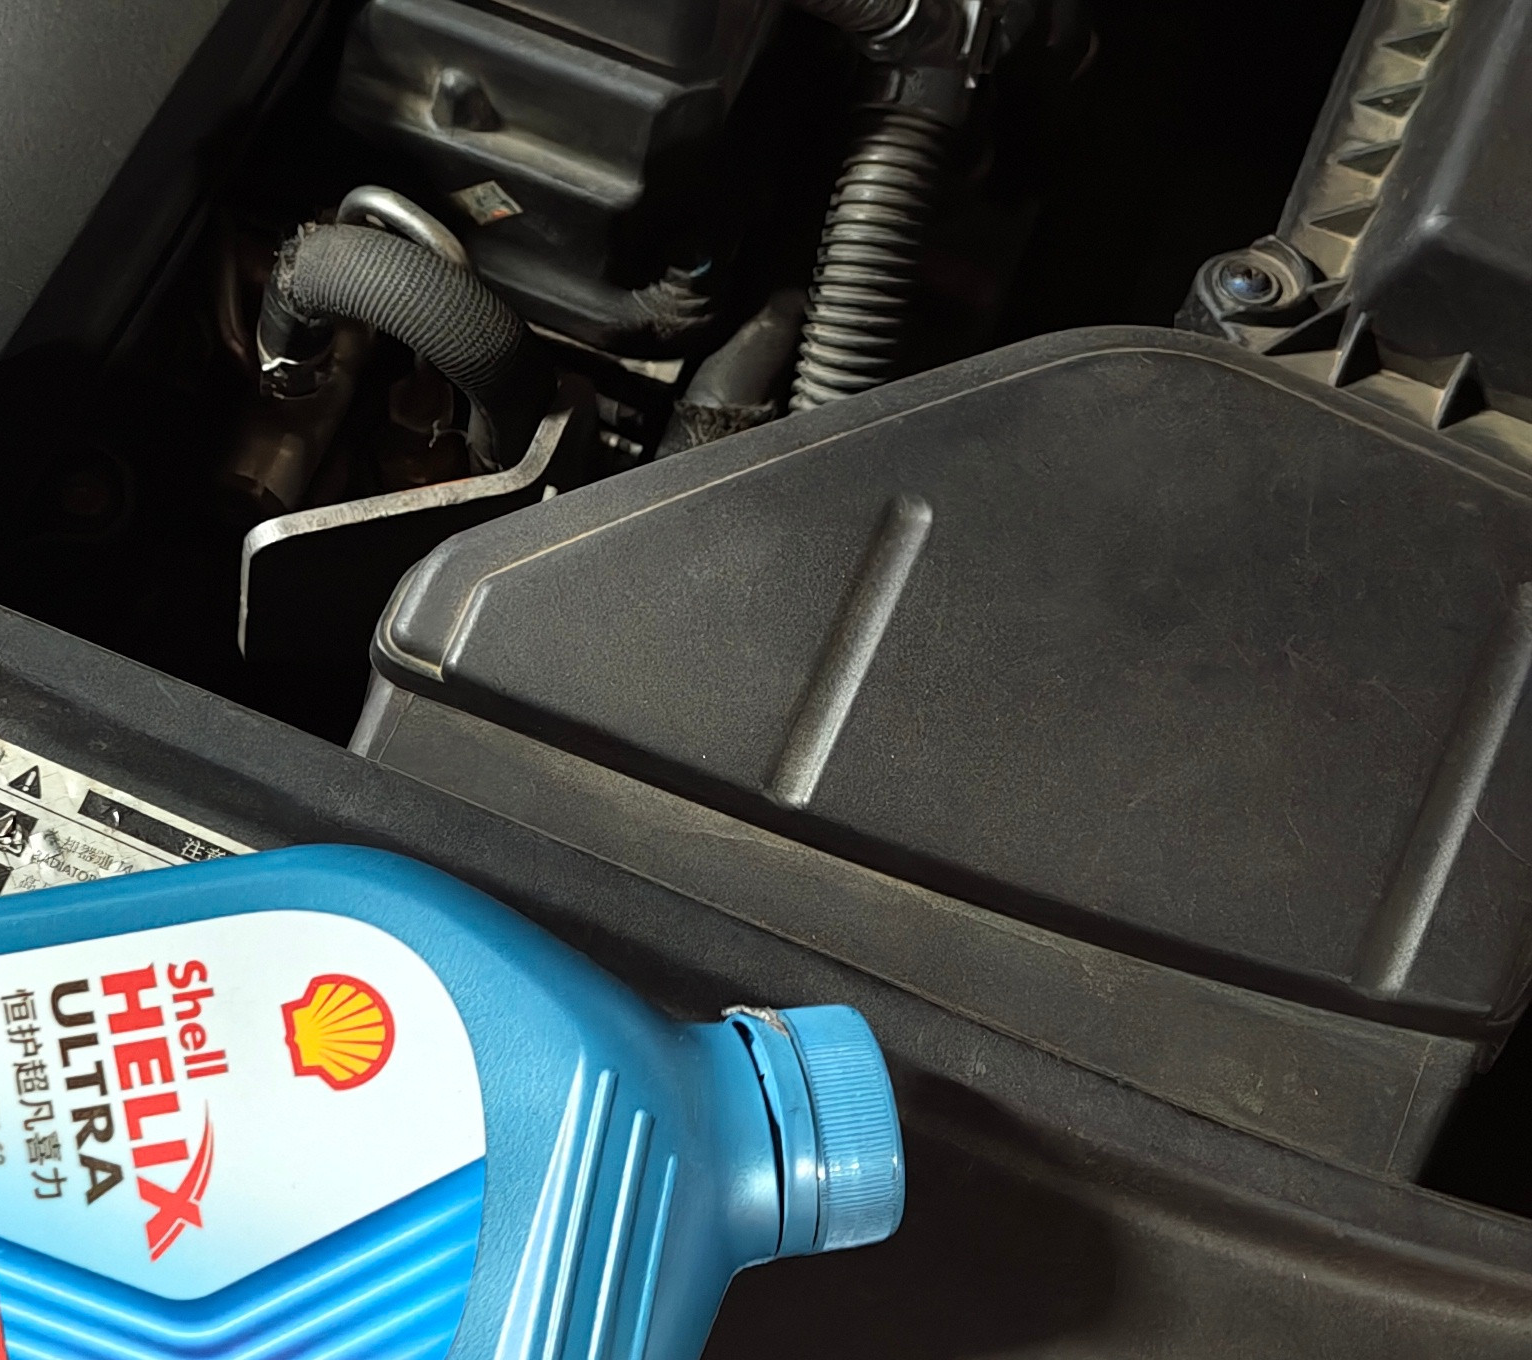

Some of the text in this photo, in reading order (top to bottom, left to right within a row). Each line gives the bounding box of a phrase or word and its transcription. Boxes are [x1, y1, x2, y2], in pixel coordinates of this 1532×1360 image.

[0, 988, 67, 1199] 恒护超凡喜力
[50, 978, 124, 1205] ULTRA
[101, 962, 214, 1262] HELIX
[167, 959, 228, 1079] Shell
